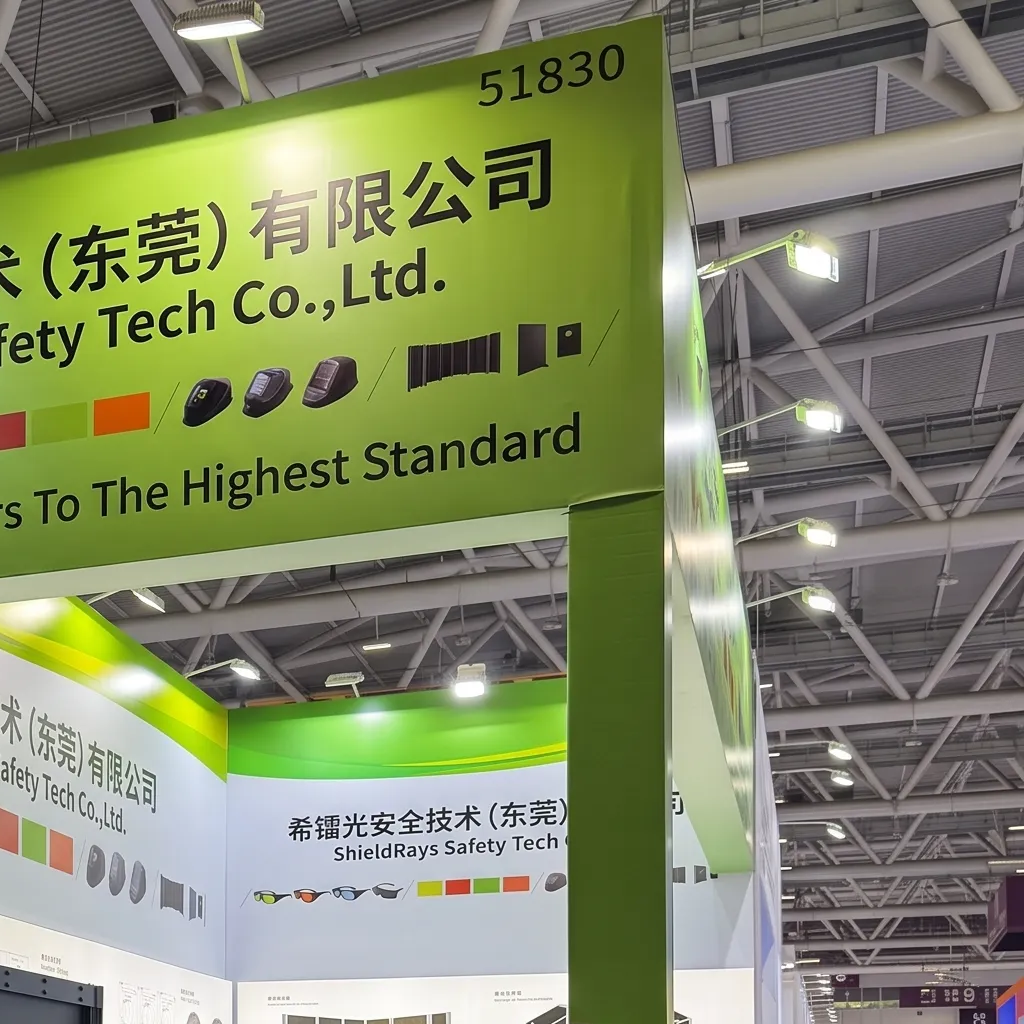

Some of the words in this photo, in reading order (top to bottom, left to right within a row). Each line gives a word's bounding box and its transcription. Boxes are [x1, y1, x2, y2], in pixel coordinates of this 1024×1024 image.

[477, 43, 626, 107] 51830
[97, 289, 216, 349] Tech
[232, 246, 446, 325] Co.,Ltd.
[33, 488, 78, 525] To
[91, 476, 169, 518] The
[182, 449, 351, 511] Highest
[362, 410, 582, 482] Standard
[42, 773, 75, 813] Tech
[78, 790, 127, 835] Co.,Ltd.
[333, 841, 439, 862] ShieldRays
[444, 837, 507, 857] Safety
[511, 832, 559, 852] Tech
